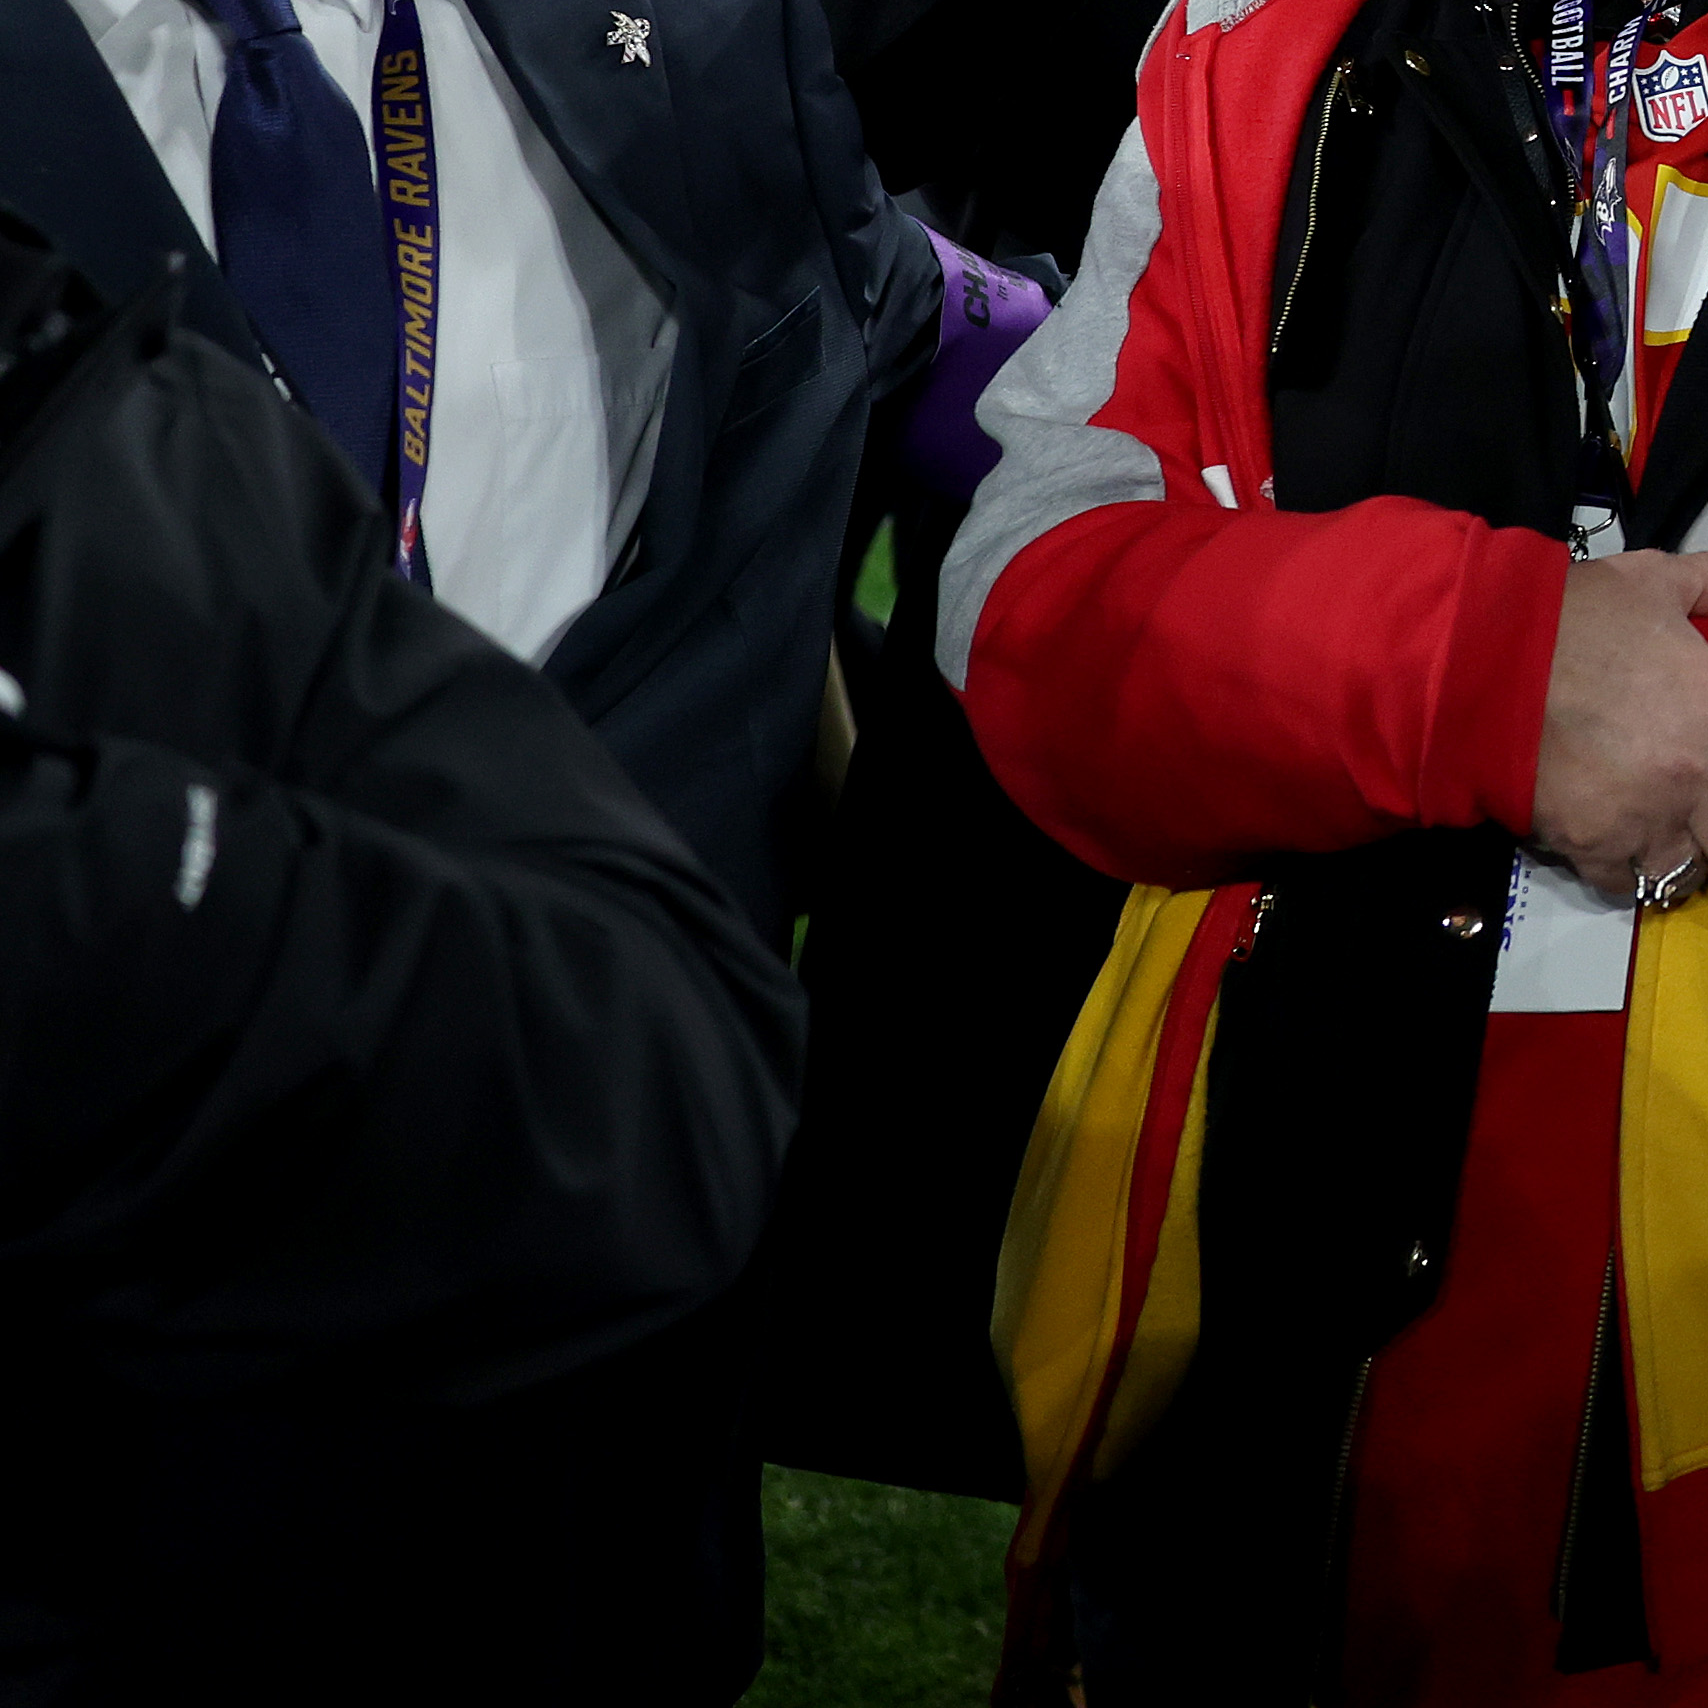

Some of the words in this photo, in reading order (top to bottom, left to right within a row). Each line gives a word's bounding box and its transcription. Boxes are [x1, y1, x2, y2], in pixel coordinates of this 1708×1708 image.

[1608, 14, 1644, 106] CHARM
[1649, 88, 1706, 134] NFL
[382, 49, 431, 207] RAVENS
[394, 217, 434, 467] BALTIMORE
